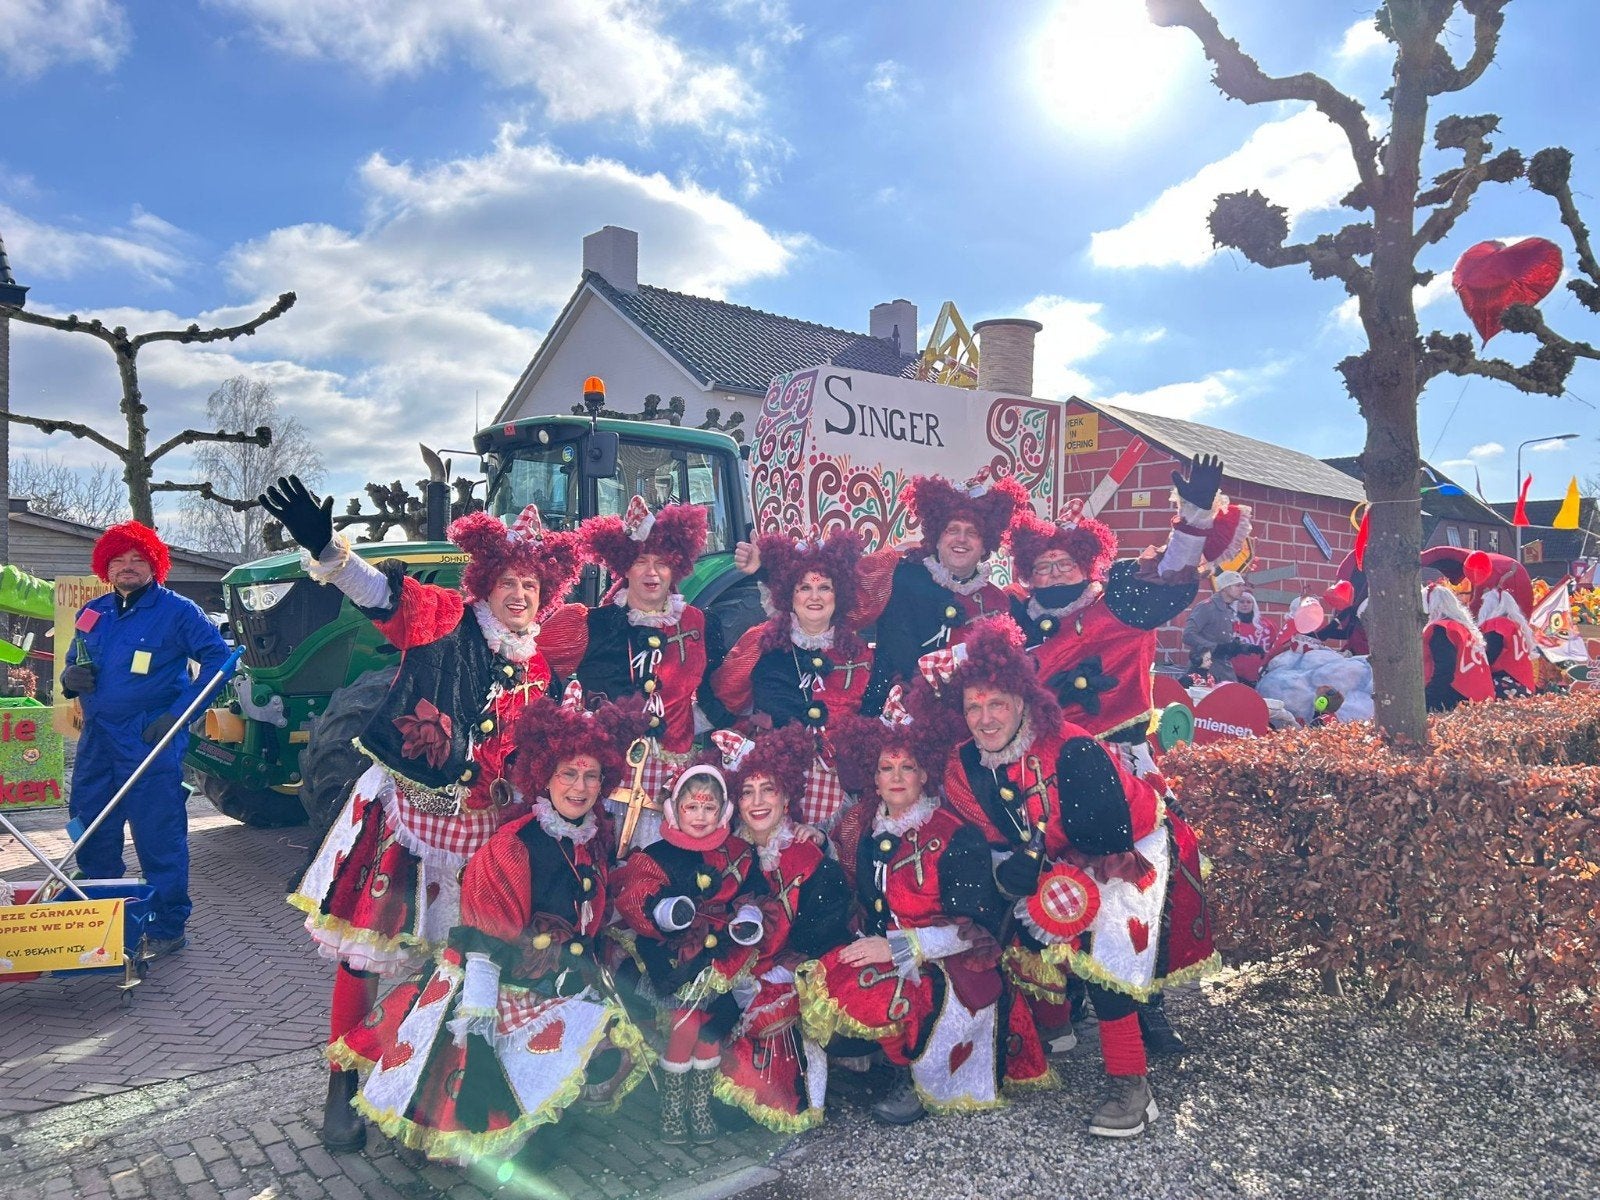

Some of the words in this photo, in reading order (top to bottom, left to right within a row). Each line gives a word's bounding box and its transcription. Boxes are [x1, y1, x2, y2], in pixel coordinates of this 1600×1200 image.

[824, 374, 945, 448] SINGER
[1070, 430, 1077, 438] IN
[1193, 716, 1254, 738] miensen
[30, 907, 100, 919] CARNAVAL
[42, 923, 61, 932] WE
[88, 920, 105, 928] OP
[24, 945, 64, 957] BEKANT
[66, 944, 86, 954] NIX
